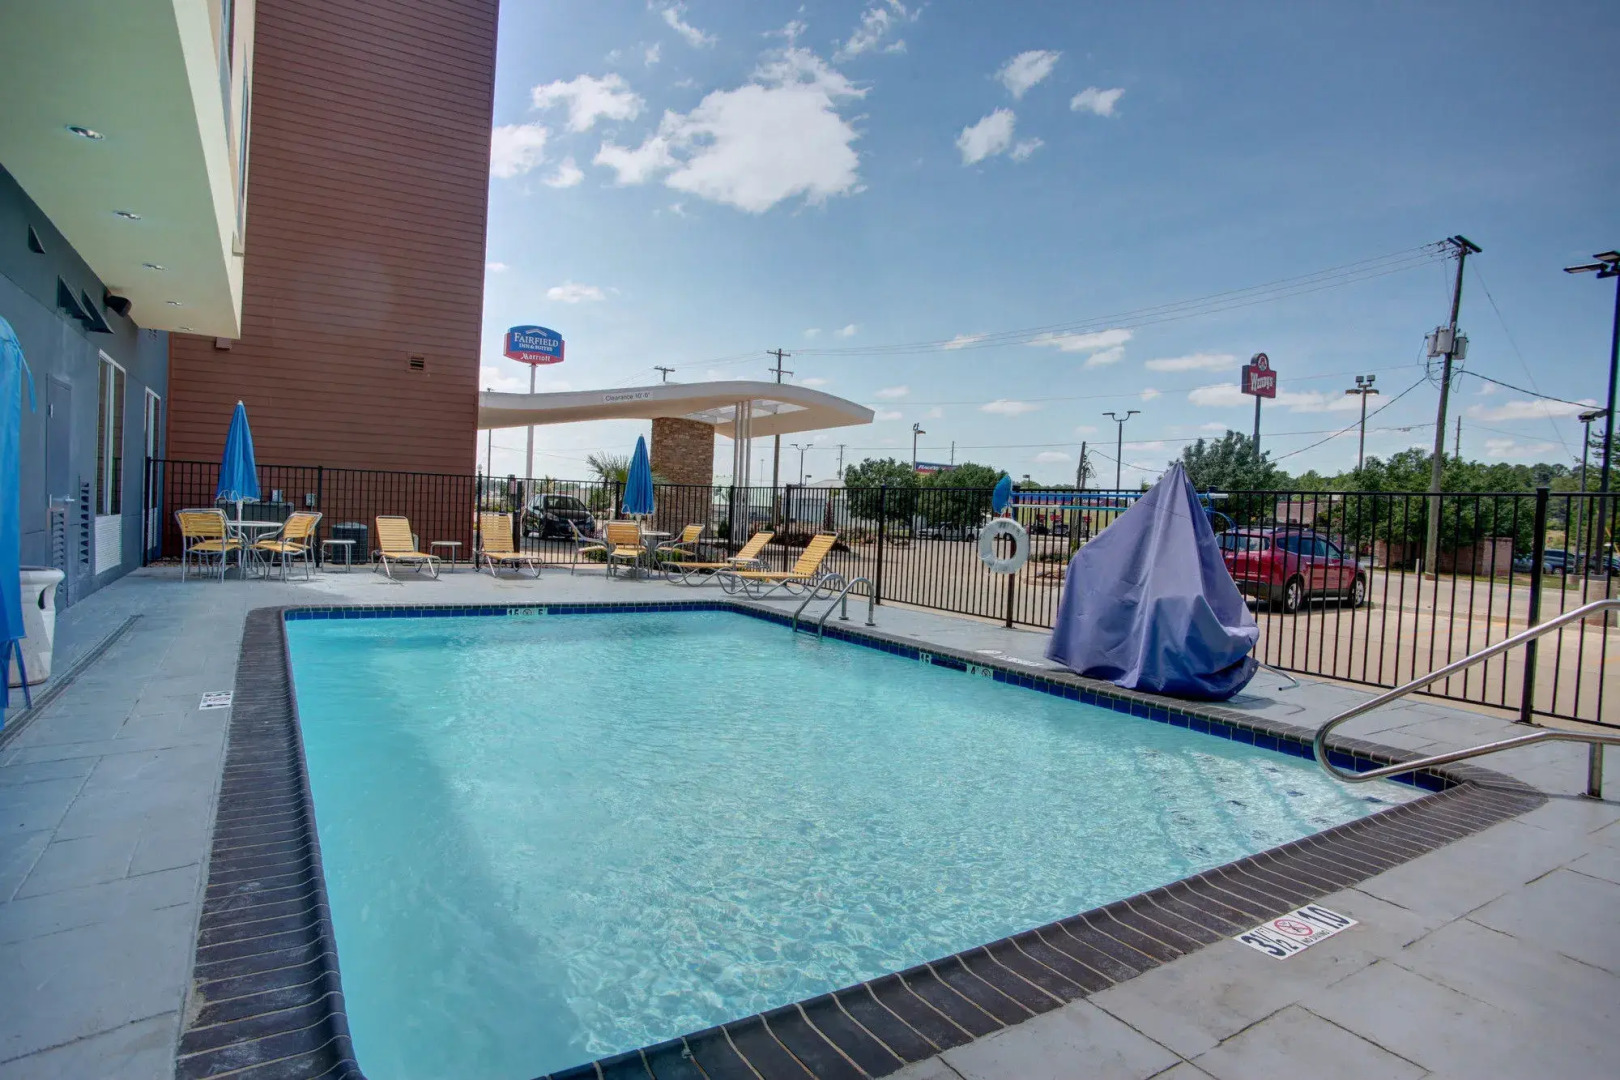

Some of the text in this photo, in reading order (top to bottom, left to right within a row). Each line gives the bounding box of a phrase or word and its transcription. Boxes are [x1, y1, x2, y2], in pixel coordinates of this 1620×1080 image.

[514, 332, 559, 347] FAIRFIELD
[521, 352, 551, 362] Marriott
[605, 394, 634, 402] Clearance
